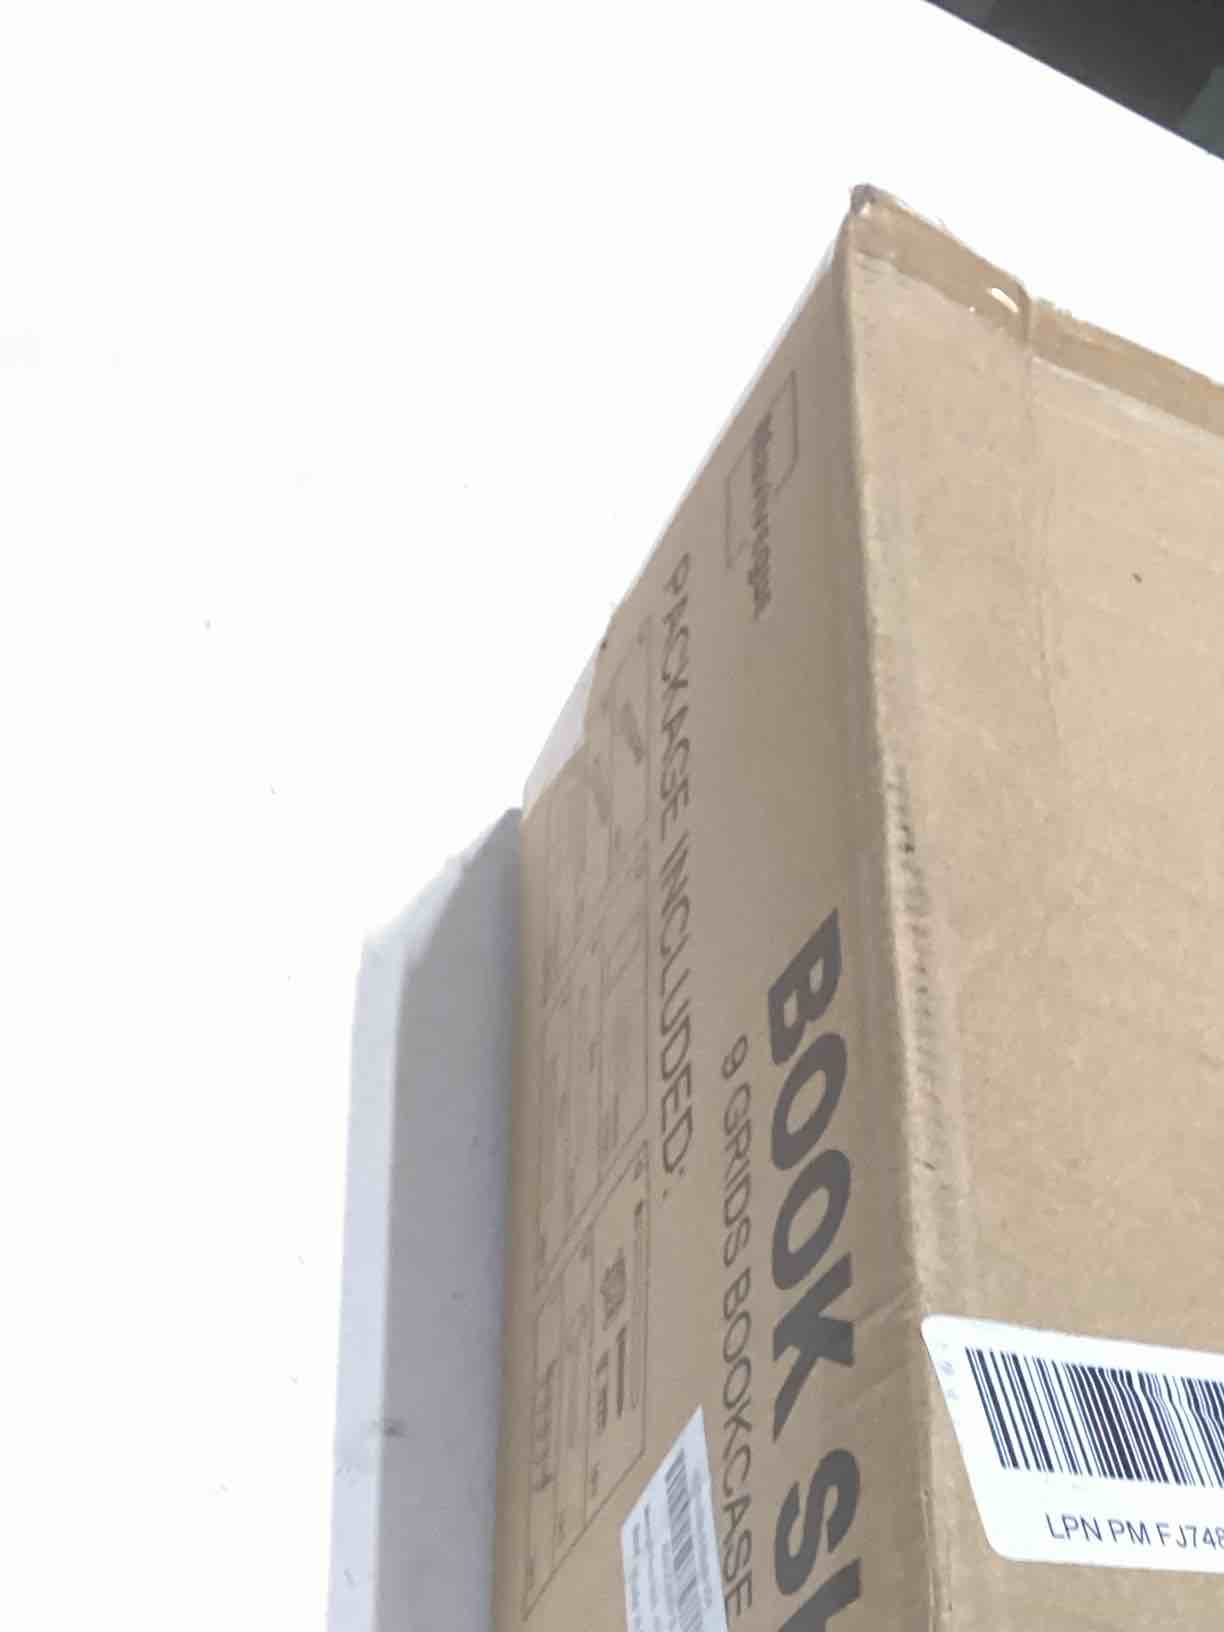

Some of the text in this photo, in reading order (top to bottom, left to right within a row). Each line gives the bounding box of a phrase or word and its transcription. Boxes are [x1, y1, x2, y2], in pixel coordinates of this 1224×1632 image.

[660, 551, 692, 842] PACKAGE
[720, 1033, 751, 1081] 9
[722, 1081, 753, 1270] GRIDS
[767, 906, 856, 1445] BOOK
[722, 1267, 755, 1618] BOOKCASE
[1045, 1512, 1102, 1543] LPN
[1107, 1518, 1150, 1546] PM
